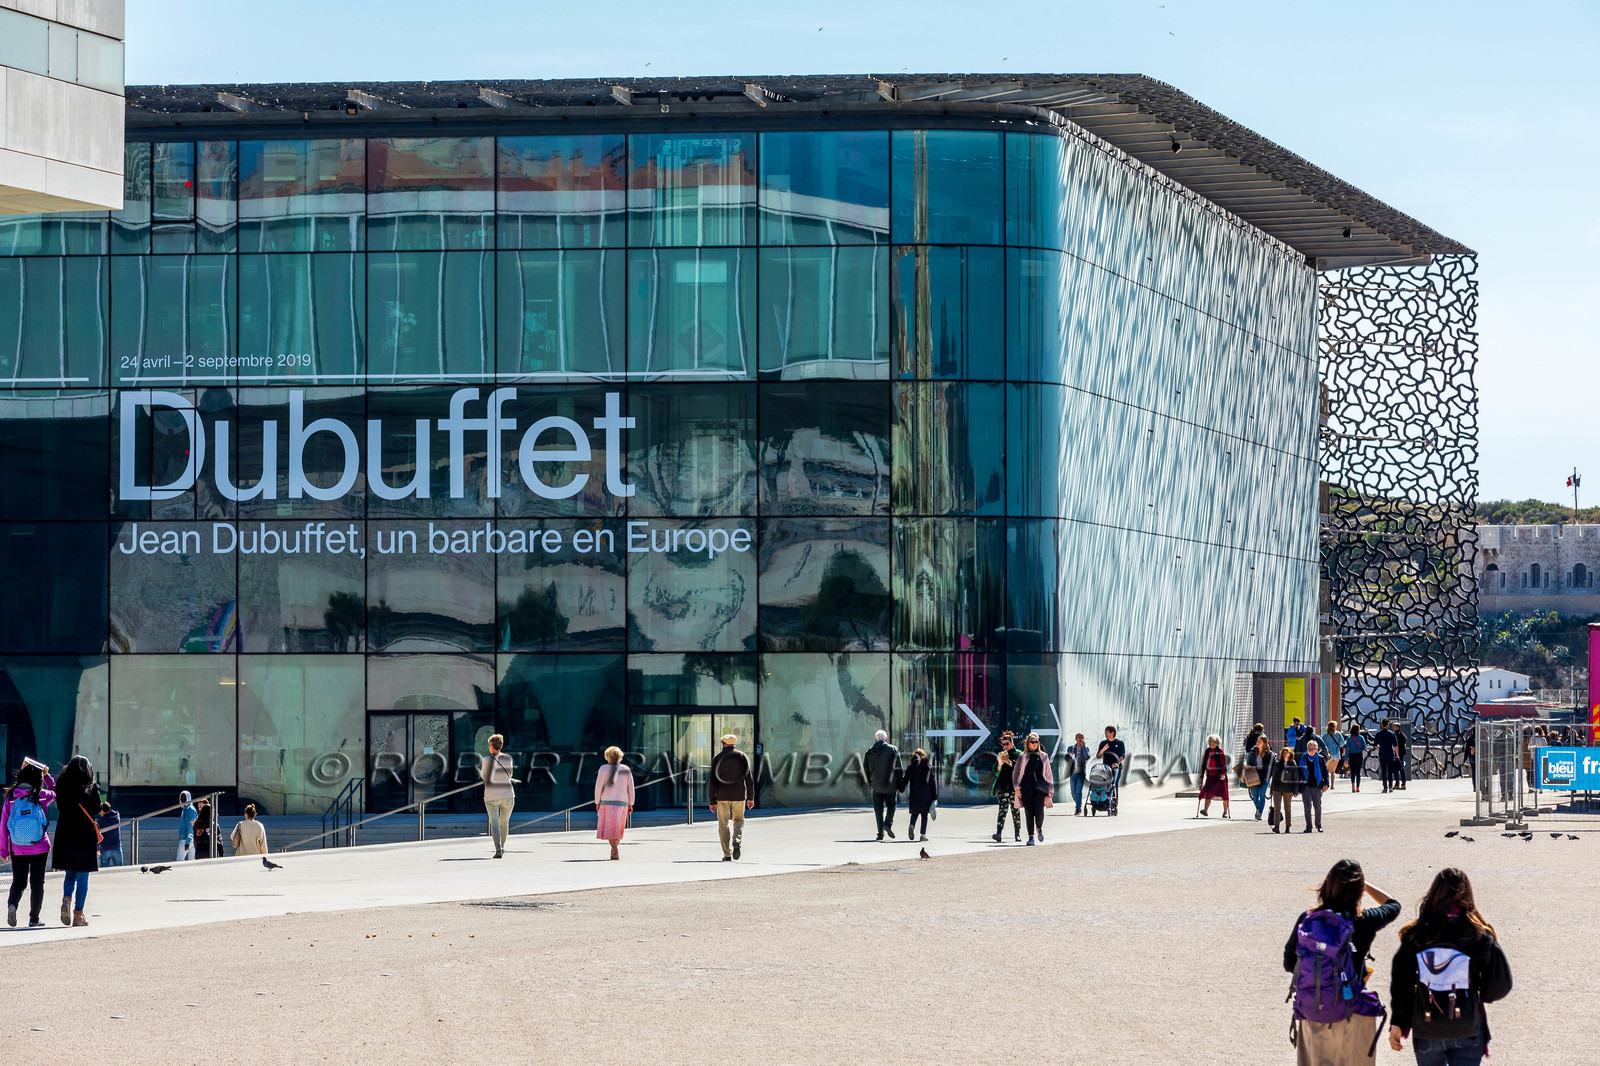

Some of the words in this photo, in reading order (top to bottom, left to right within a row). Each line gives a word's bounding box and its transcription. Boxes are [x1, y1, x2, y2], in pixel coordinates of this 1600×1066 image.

[120, 354, 139, 369] 24
[142, 354, 171, 369] avril
[185, 354, 194, 368] 2
[198, 353, 273, 369] septembre
[277, 353, 311, 367] 2019
[119, 387, 636, 501] Dubuffet
[119, 522, 201, 555] Jean
[212, 521, 366, 558] Dubuffet,
[376, 529, 417, 555] un
[428, 521, 562, 554] barbare
[573, 528, 615, 553] en
[626, 521, 752, 559] Europe
[1549, 762, 1574, 773] bleu
[1582, 756, 1600, 774] fr
